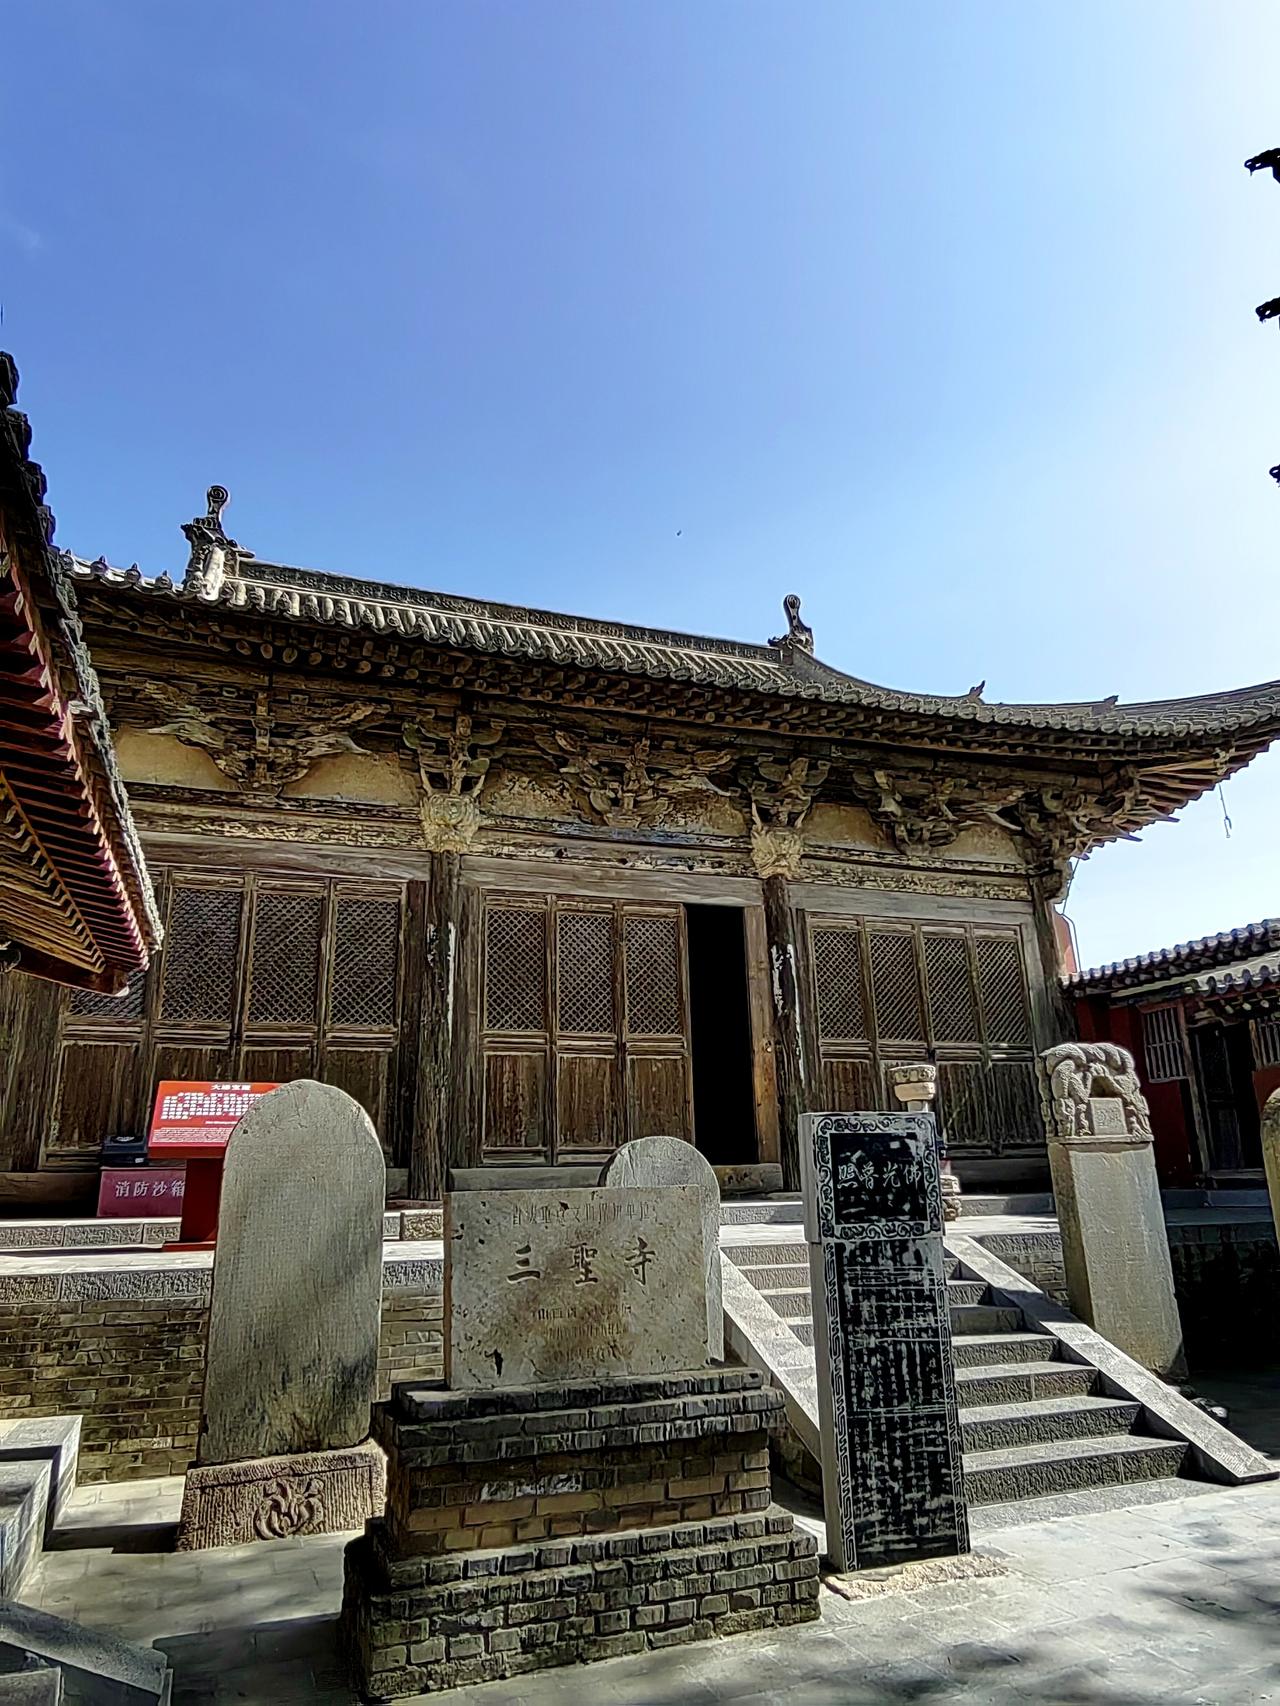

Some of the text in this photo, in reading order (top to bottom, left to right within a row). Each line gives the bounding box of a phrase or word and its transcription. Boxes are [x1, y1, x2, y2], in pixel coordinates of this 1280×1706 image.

[115, 1181, 185, 1197] 消防沙箱
[506, 1237, 656, 1286] 三聖寺
